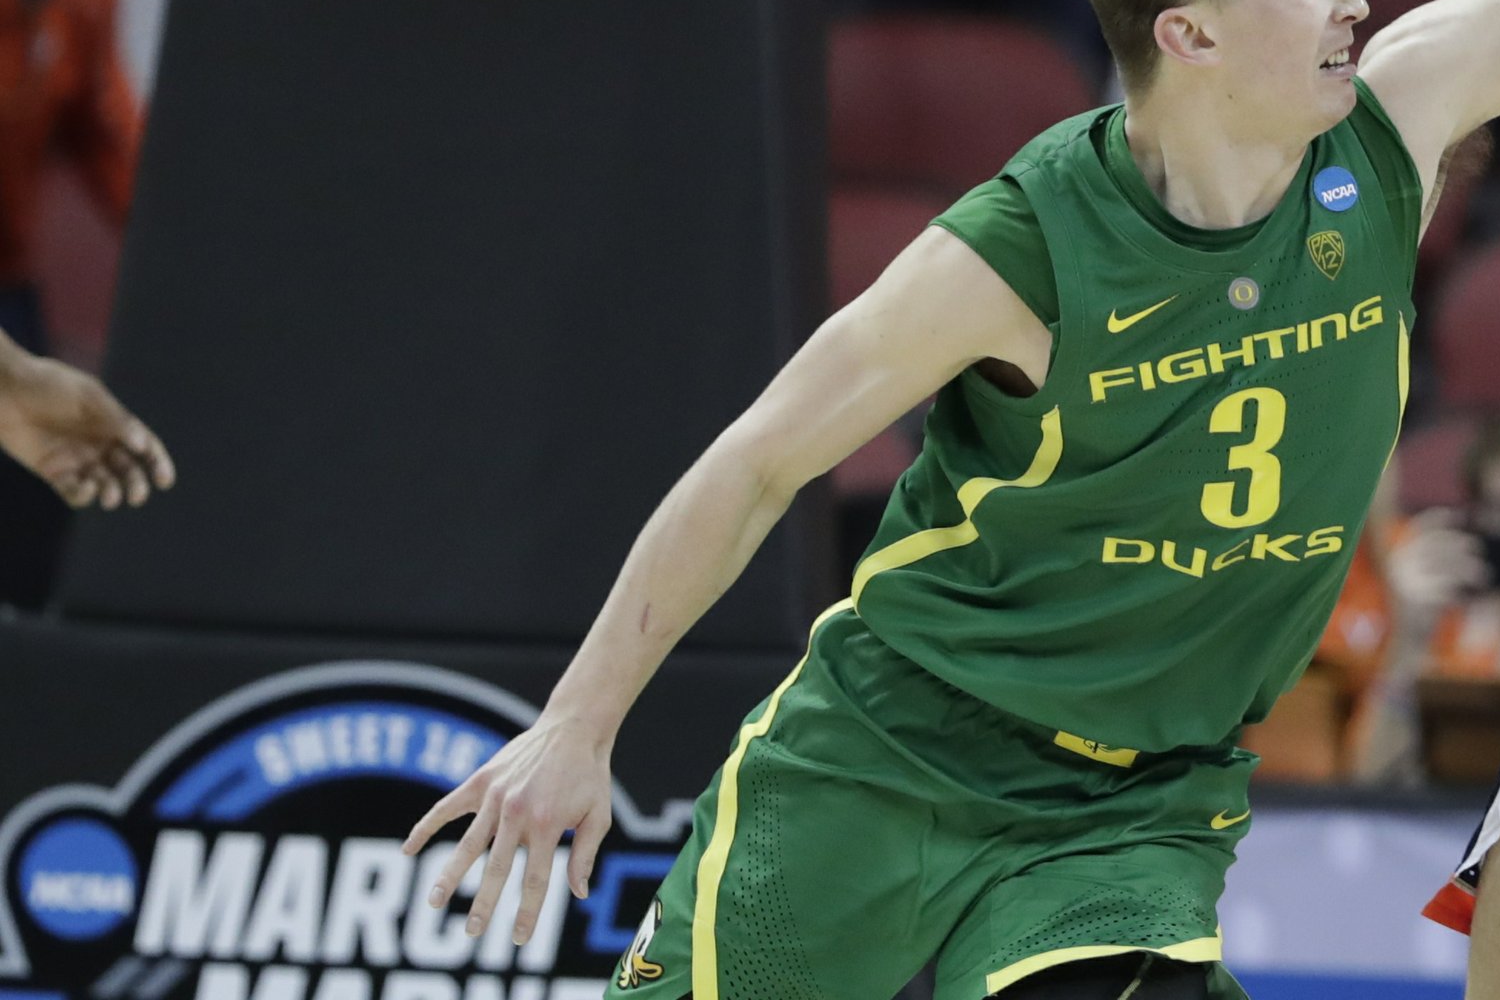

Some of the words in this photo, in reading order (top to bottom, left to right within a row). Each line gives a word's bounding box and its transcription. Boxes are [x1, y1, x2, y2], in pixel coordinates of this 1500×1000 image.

[1321, 183, 1357, 203] NCAA
[1321, 250, 1339, 270] 12
[1089, 295, 1383, 403] FIGHTING
[1200, 387, 1286, 529] 3
[1102, 526, 1344, 578] DUCKS
[254, 712, 414, 786] SWEET
[133, 828, 572, 973] MARCH
